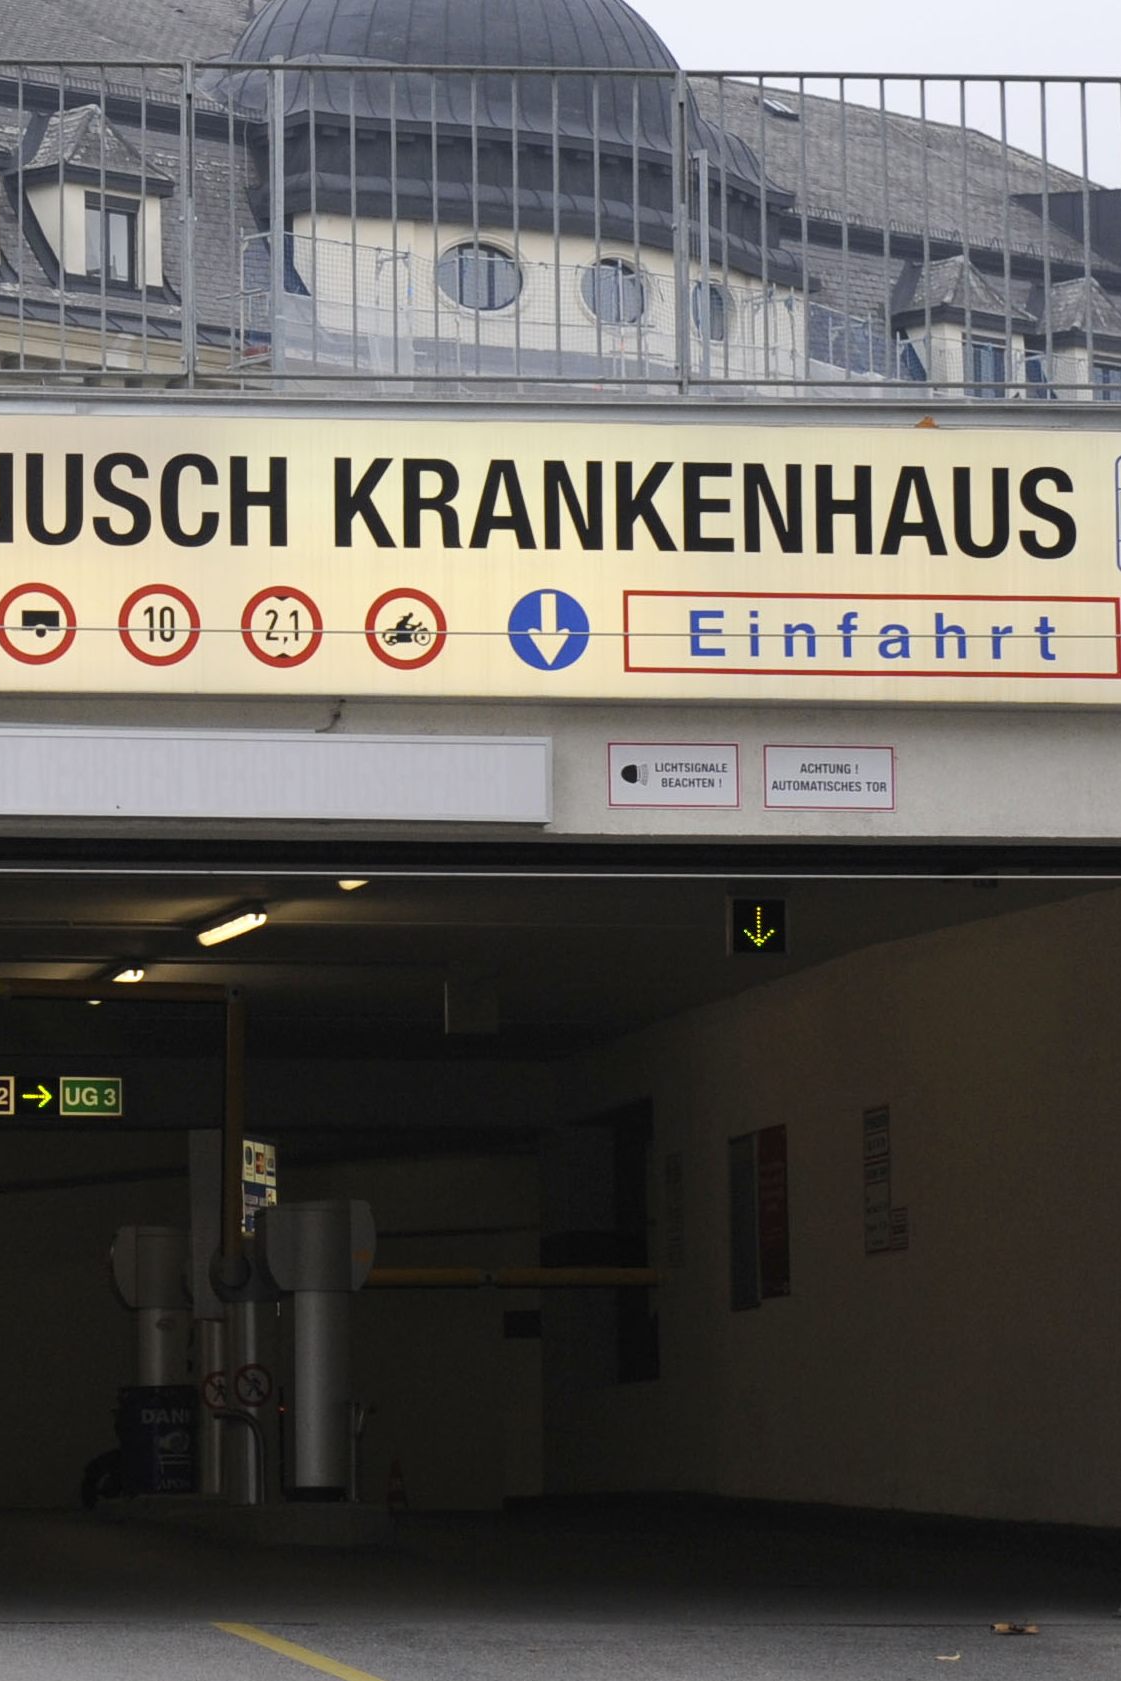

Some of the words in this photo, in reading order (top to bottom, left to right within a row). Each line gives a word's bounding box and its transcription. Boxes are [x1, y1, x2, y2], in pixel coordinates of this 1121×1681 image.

[335, 458, 1076, 559] KRANKENHAUS
[144, 606, 175, 641] 10
[265, 609, 300, 644] 2,1
[691, 610, 1056, 661] Einfahrt
[654, 762, 728, 773] LICHTSIGNALE
[799, 762, 852, 775] ACHTUNG
[661, 777, 715, 788] BEACHTEN
[771, 780, 862, 793] AUTOMATISCHES
[865, 781, 887, 793] TOR
[66, 1087, 98, 1105] UG
[104, 1088, 115, 1106] 3
